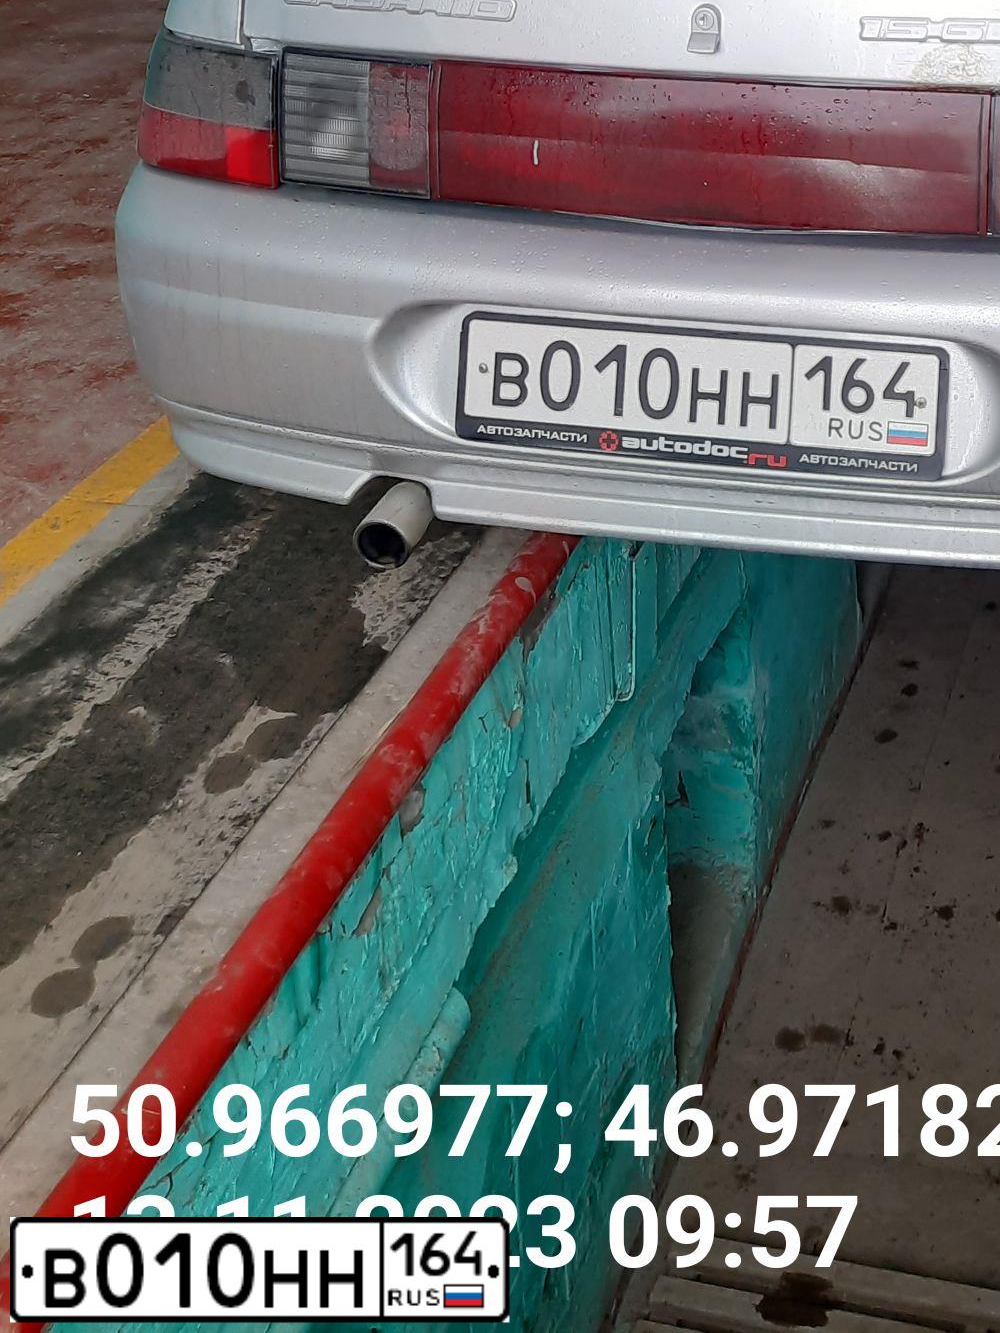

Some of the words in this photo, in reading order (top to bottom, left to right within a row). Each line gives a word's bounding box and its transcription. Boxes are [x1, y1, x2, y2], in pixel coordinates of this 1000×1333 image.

[491, 340, 780, 430] В010НН
[804, 356, 917, 418] 164
[477, 424, 588, 444] АВТОЗАПЧАСТИ
[828, 418, 884, 442] RUS
[620, 435, 788, 468] autodoc.ru
[799, 453, 919, 473] АВТОЗАПЧАСТИ
